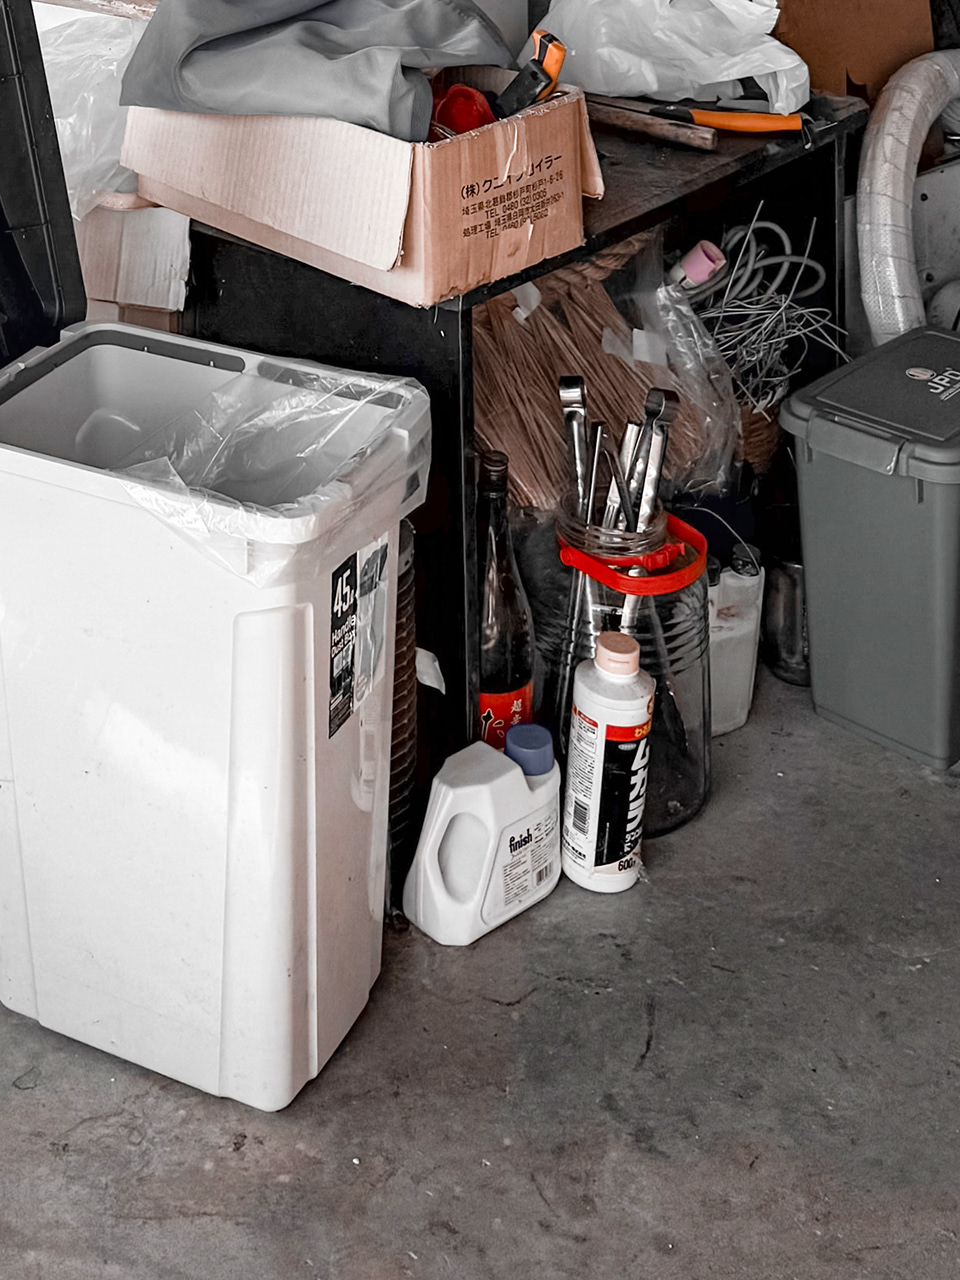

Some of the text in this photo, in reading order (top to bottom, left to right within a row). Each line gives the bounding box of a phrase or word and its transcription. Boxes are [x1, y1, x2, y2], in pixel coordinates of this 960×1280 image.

[485, 209, 499, 220] TEL
[485, 230, 499, 239] TEL
[509, 828, 533, 853] finish
